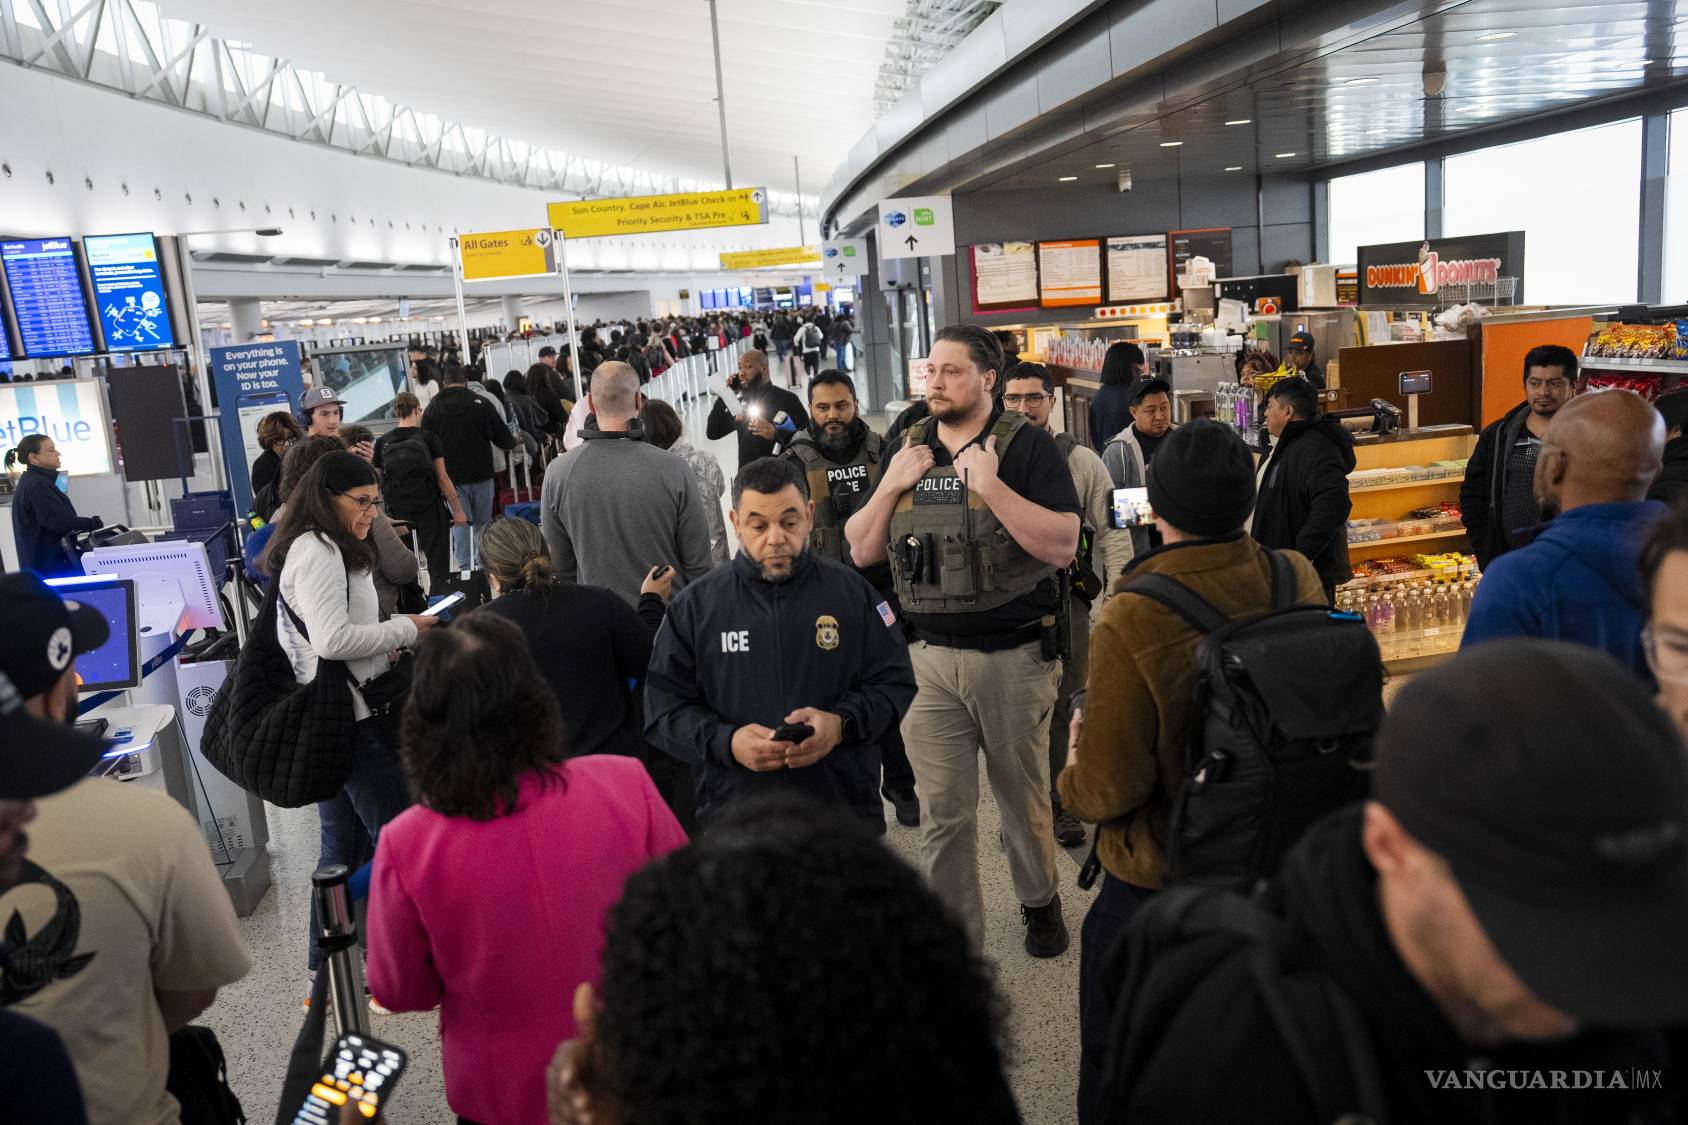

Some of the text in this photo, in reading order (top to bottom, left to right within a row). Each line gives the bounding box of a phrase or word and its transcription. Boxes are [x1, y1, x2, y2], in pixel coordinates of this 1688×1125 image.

[572, 206, 588, 215] Sun
[629, 202, 650, 211] Cape
[617, 217, 647, 226] Priority
[650, 214, 683, 225] Security
[686, 212, 692, 221] &
[694, 212, 710, 220] TSA
[712, 211, 725, 219] Pre
[464, 239, 509, 250] All Gates
[225, 346, 283, 360] Everything is
[223, 358, 288, 371] on your phone.
[236, 369, 279, 380] Now your
[241, 380, 278, 390] ID is too.
[827, 465, 867, 482] POLICE
[916, 477, 960, 491] POLICE
[721, 630, 750, 652] ICE
